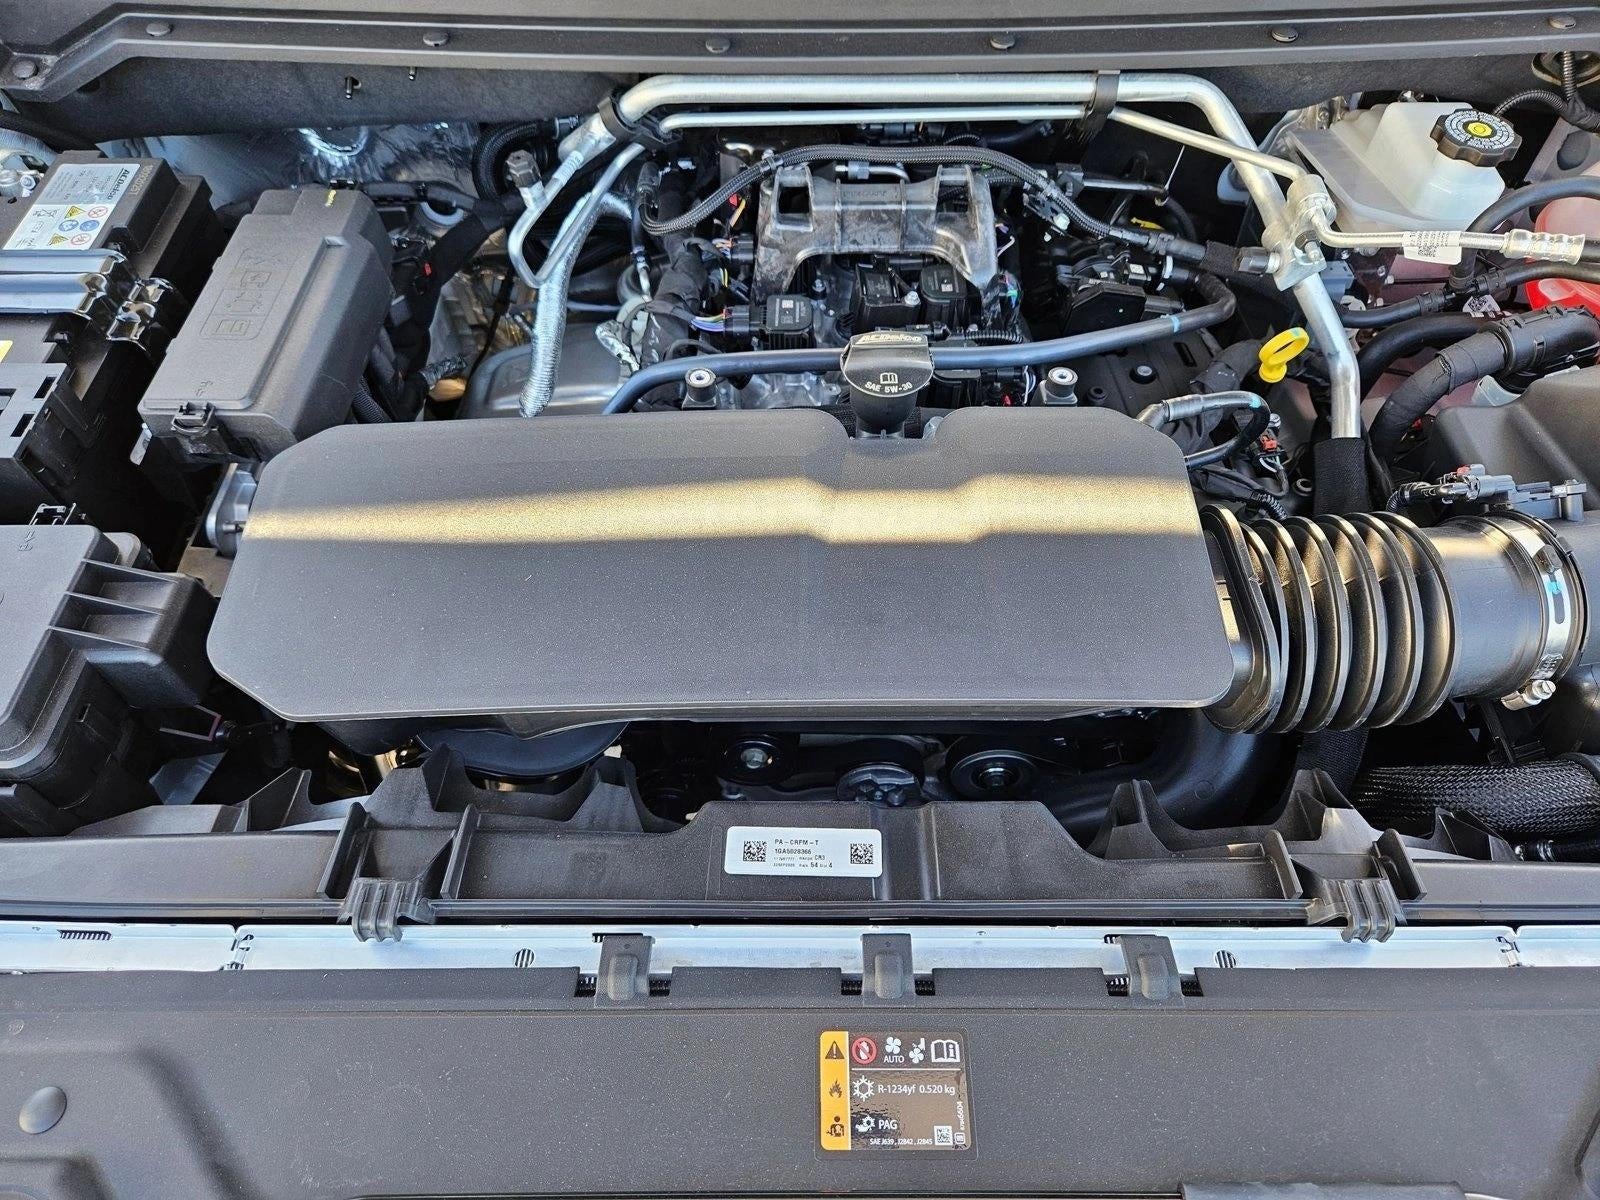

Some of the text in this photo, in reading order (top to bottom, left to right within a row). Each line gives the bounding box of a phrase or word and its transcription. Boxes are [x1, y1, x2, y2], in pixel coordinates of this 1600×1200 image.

[865, 381, 913, 393] SAE 5W-30
[883, 1055, 905, 1063] AUTO
[877, 1084, 956, 1095] R-1234yf 0.520 kg
[878, 1119, 898, 1130] PAG
